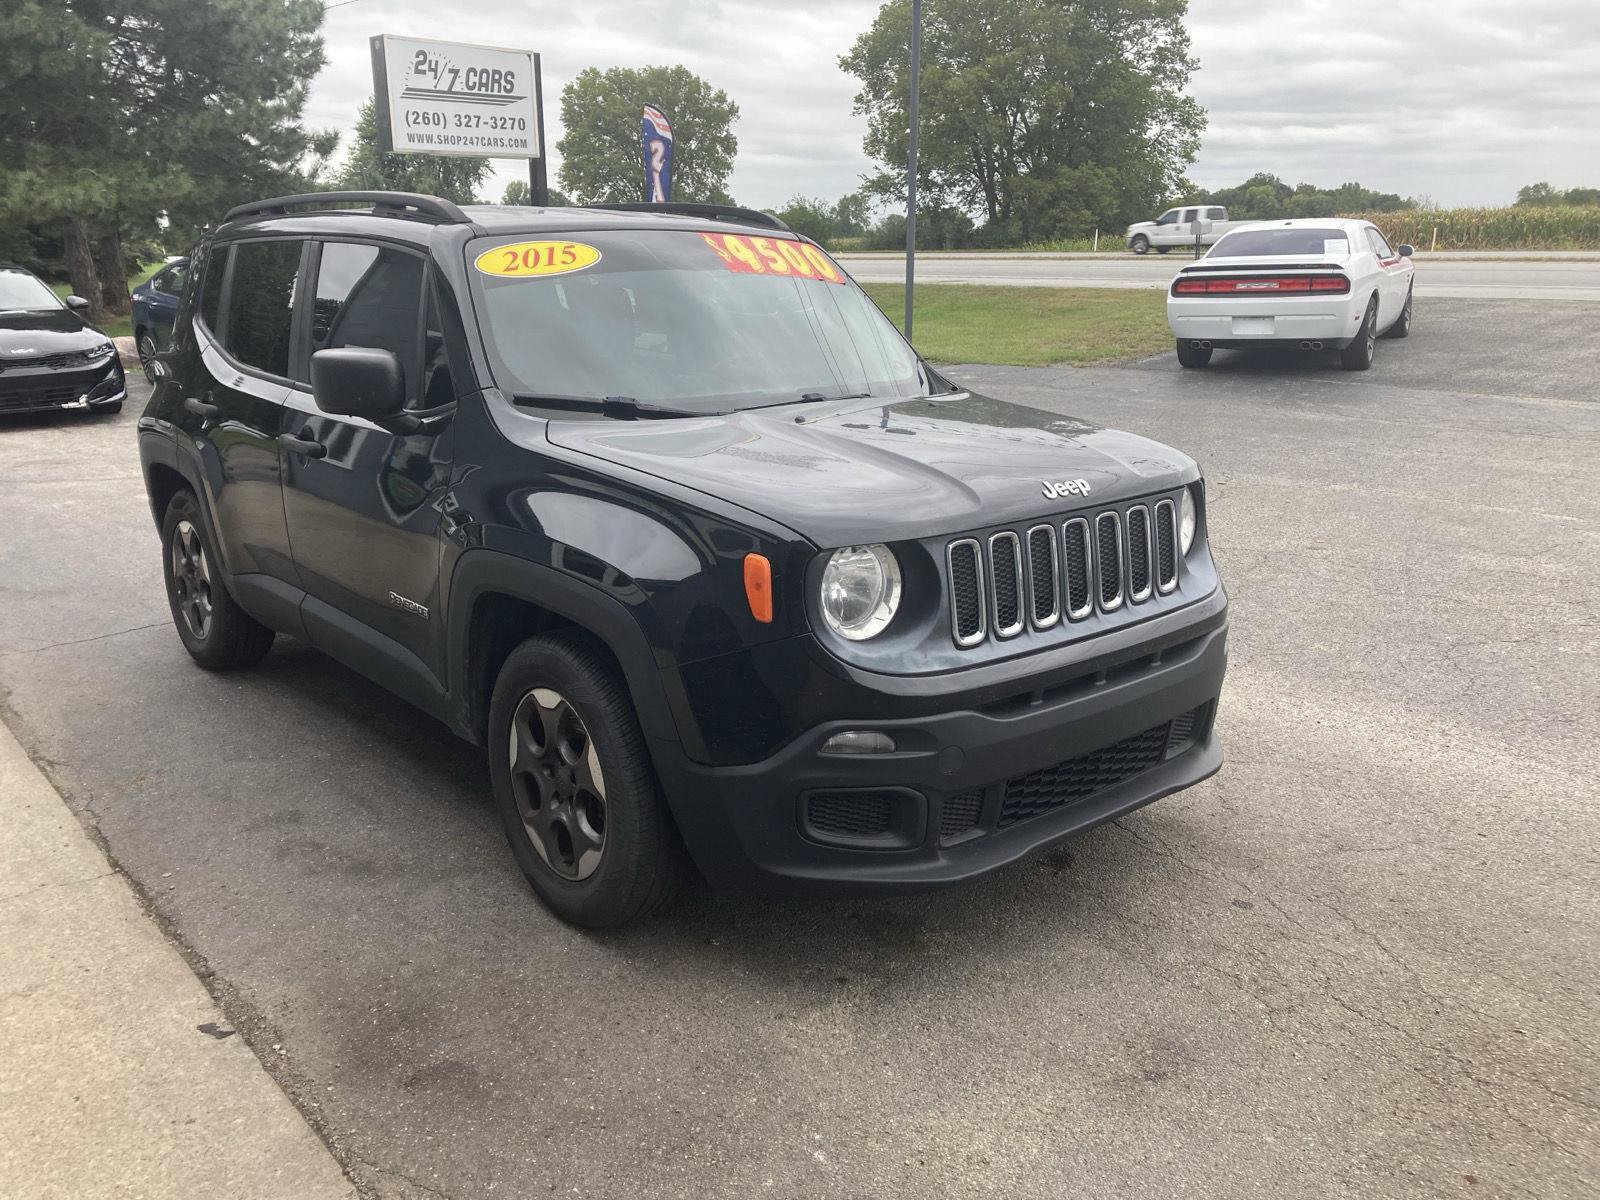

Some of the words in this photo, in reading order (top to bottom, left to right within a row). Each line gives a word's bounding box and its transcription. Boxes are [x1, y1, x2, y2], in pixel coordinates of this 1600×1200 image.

[414, 49, 460, 91] 24/7
[465, 67, 515, 94] CARS
[405, 109, 447, 130] (260)
[454, 113, 526, 131] 327-3270
[406, 132, 528, 149] WWW.SHOP247CARS.COM
[502, 244, 577, 273] 2015
[702, 233, 838, 282] $4500
[1041, 478, 1091, 500] Jeep
